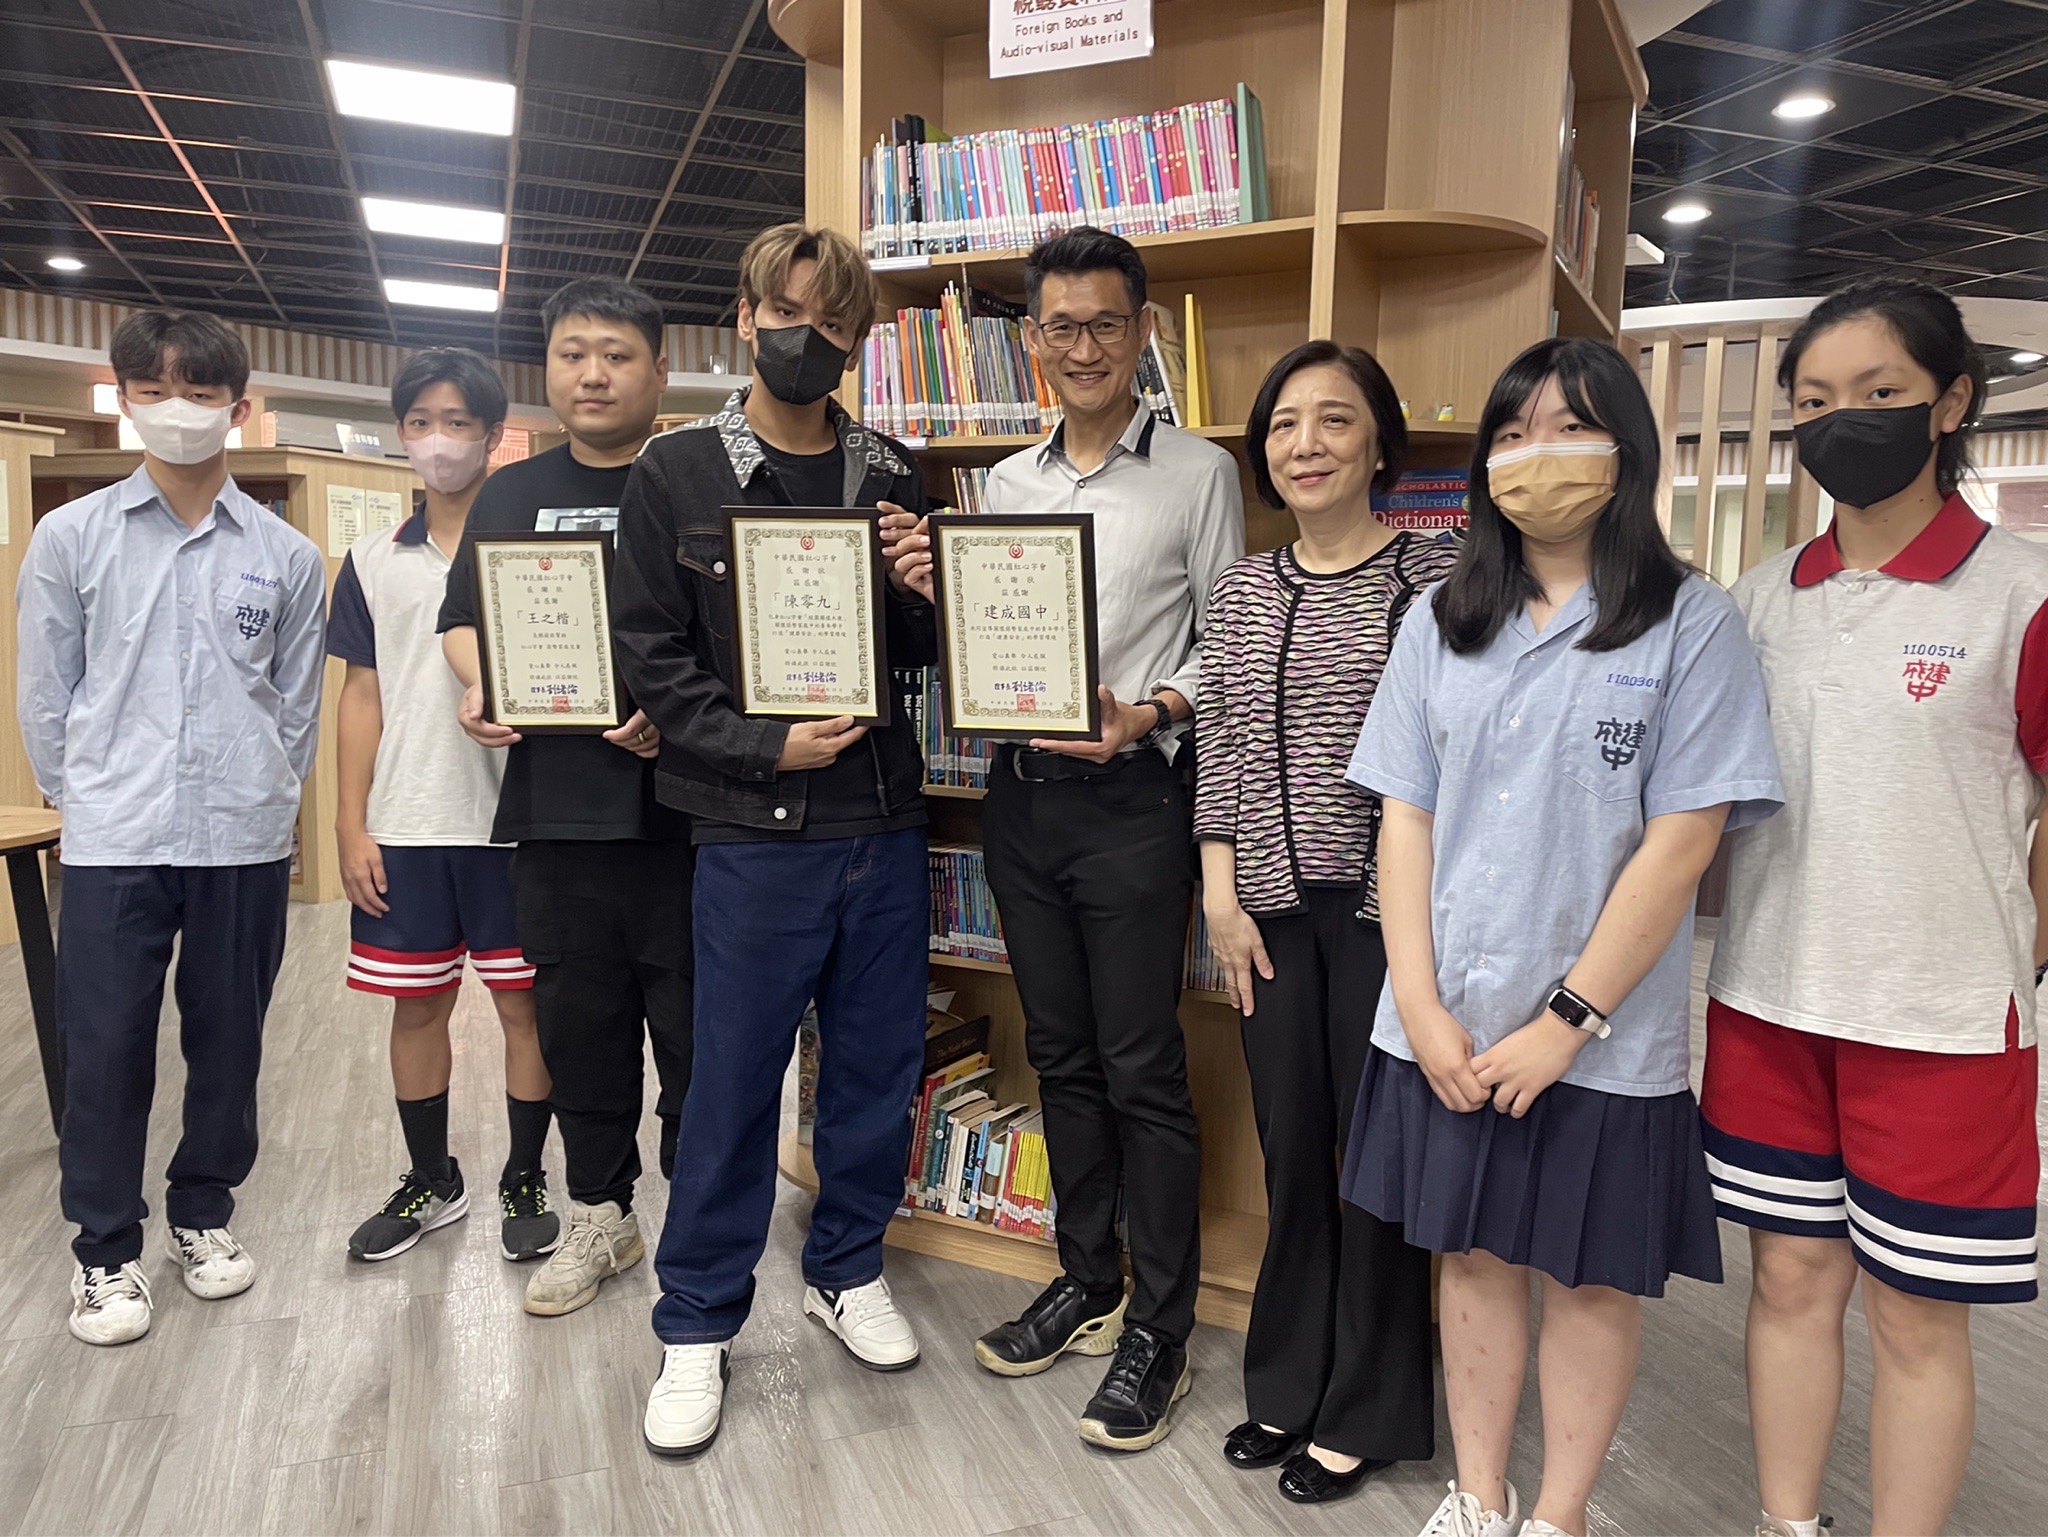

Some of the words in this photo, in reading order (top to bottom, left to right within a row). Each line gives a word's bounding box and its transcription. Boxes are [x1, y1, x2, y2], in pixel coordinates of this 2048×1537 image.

[1015, 20, 1060, 37] Foreign
[1065, 14, 1097, 30] Books
[1103, 9, 1124, 24] and
[1000, 37, 1074, 59] Audio-visual
[1080, 28, 1139, 47] Materials
[1394, 481, 1467, 491] SCHOLASTIC
[1388, 493, 1460, 509] Children's
[1372, 510, 1471, 528] Dictionar
[981, 563, 1047, 571] 中華民國紅心字會
[974, 602, 1059, 621] 「建成國中」
[1902, 643, 1968, 659] 1100514
